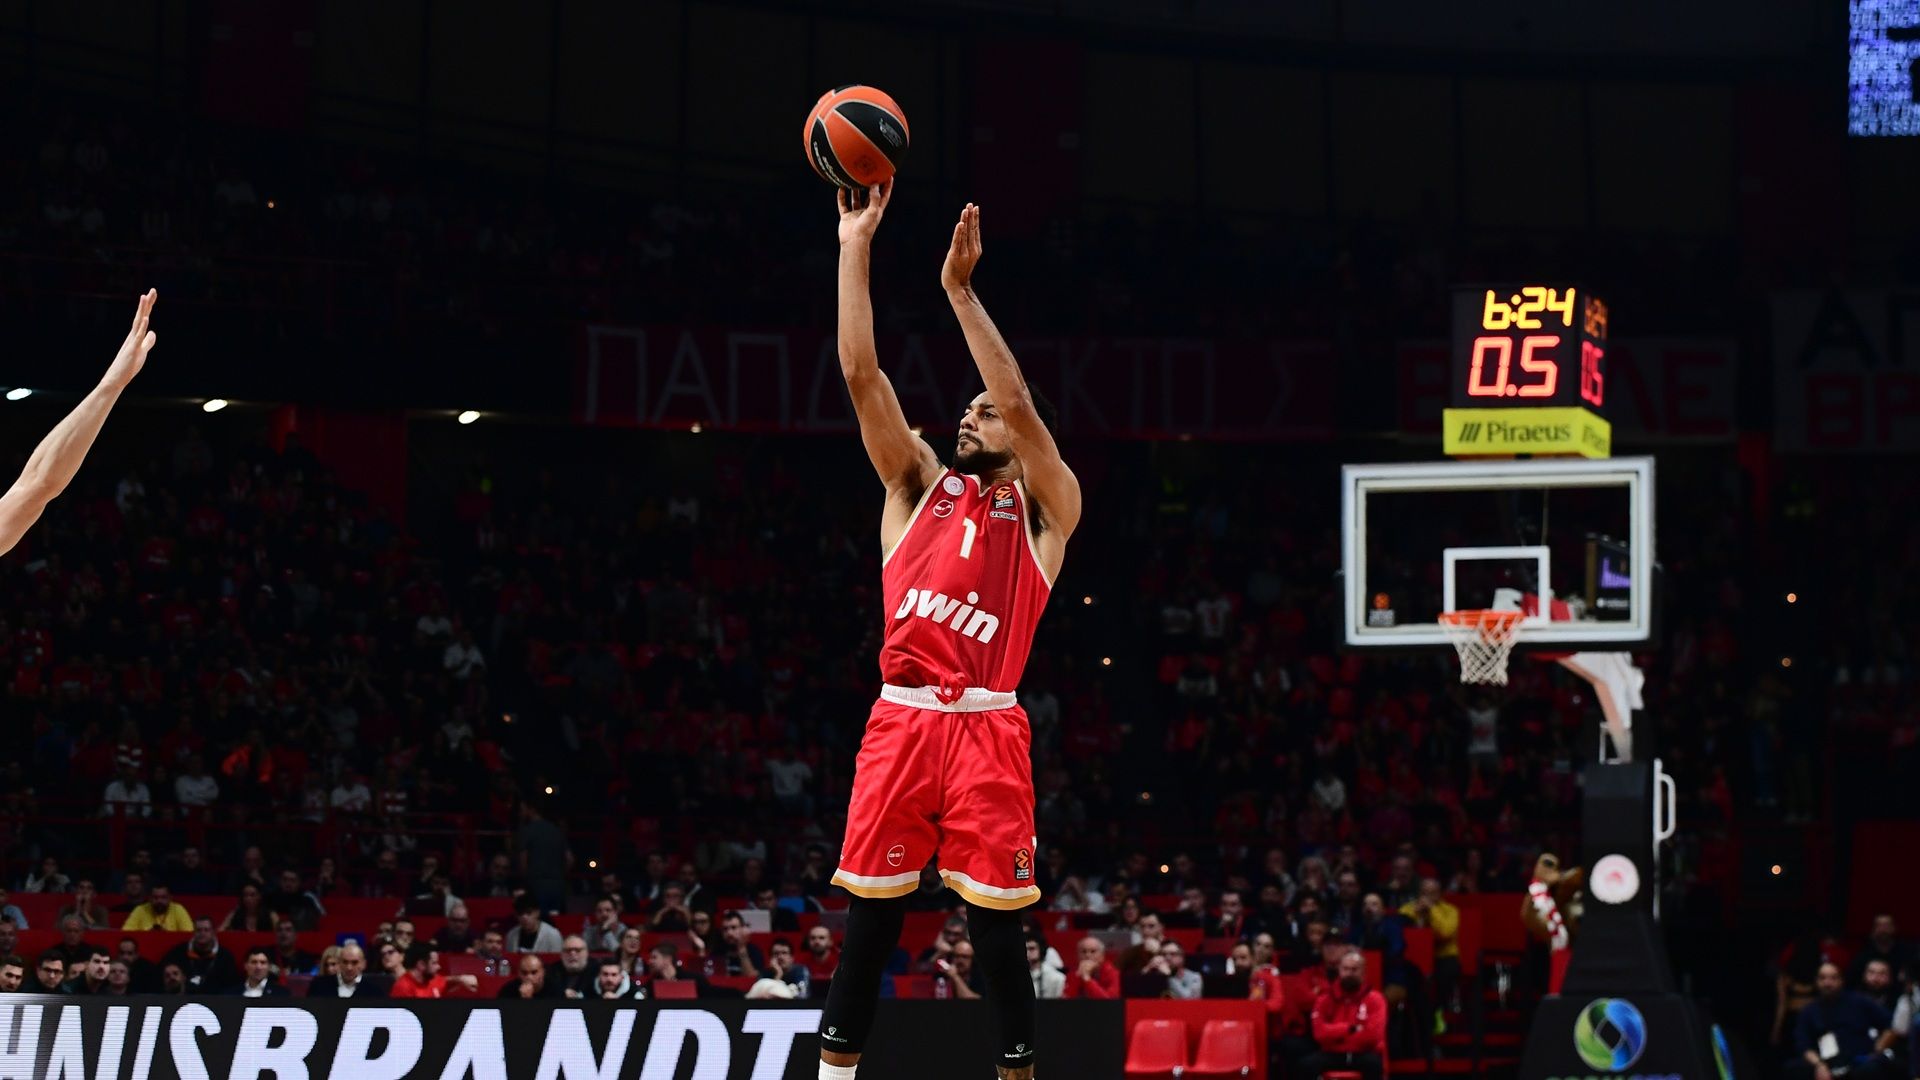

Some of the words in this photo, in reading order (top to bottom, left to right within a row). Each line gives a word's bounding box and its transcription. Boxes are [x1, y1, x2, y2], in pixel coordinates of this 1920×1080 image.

[1483, 287, 1575, 330] 6:24
[1468, 336, 1560, 396] 0.5
[1487, 421, 1571, 443] Piraeus
[959, 517, 977, 560] 1
